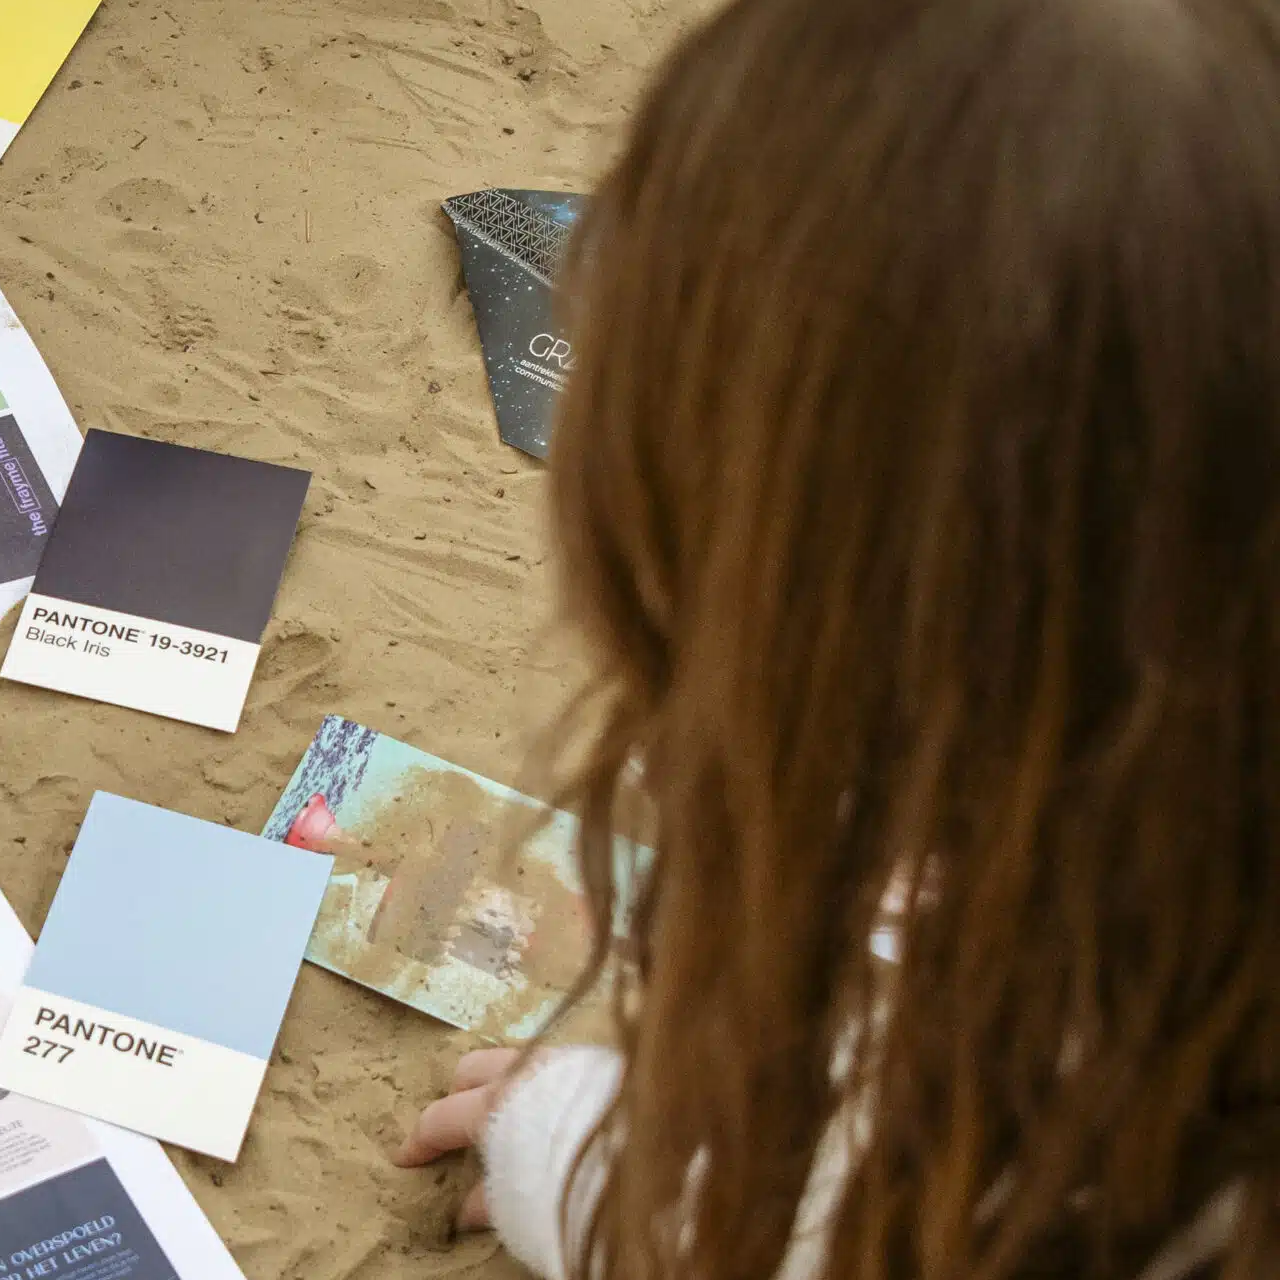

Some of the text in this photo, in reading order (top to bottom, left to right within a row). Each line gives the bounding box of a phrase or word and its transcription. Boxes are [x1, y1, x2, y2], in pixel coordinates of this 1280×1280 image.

[4, 461, 35, 509] frayme
[29, 511, 47, 536] the
[25, 626, 111, 658] Black Iris
[32, 607, 229, 664] PANTONE 19-3921
[22, 1035, 75, 1064] 277
[34, 1006, 178, 1067] PANTONE
[10, 1215, 116, 1266] OVERSPOELD
[25, 1255, 59, 1280] HET
[62, 1231, 123, 1265] LEVEN?
